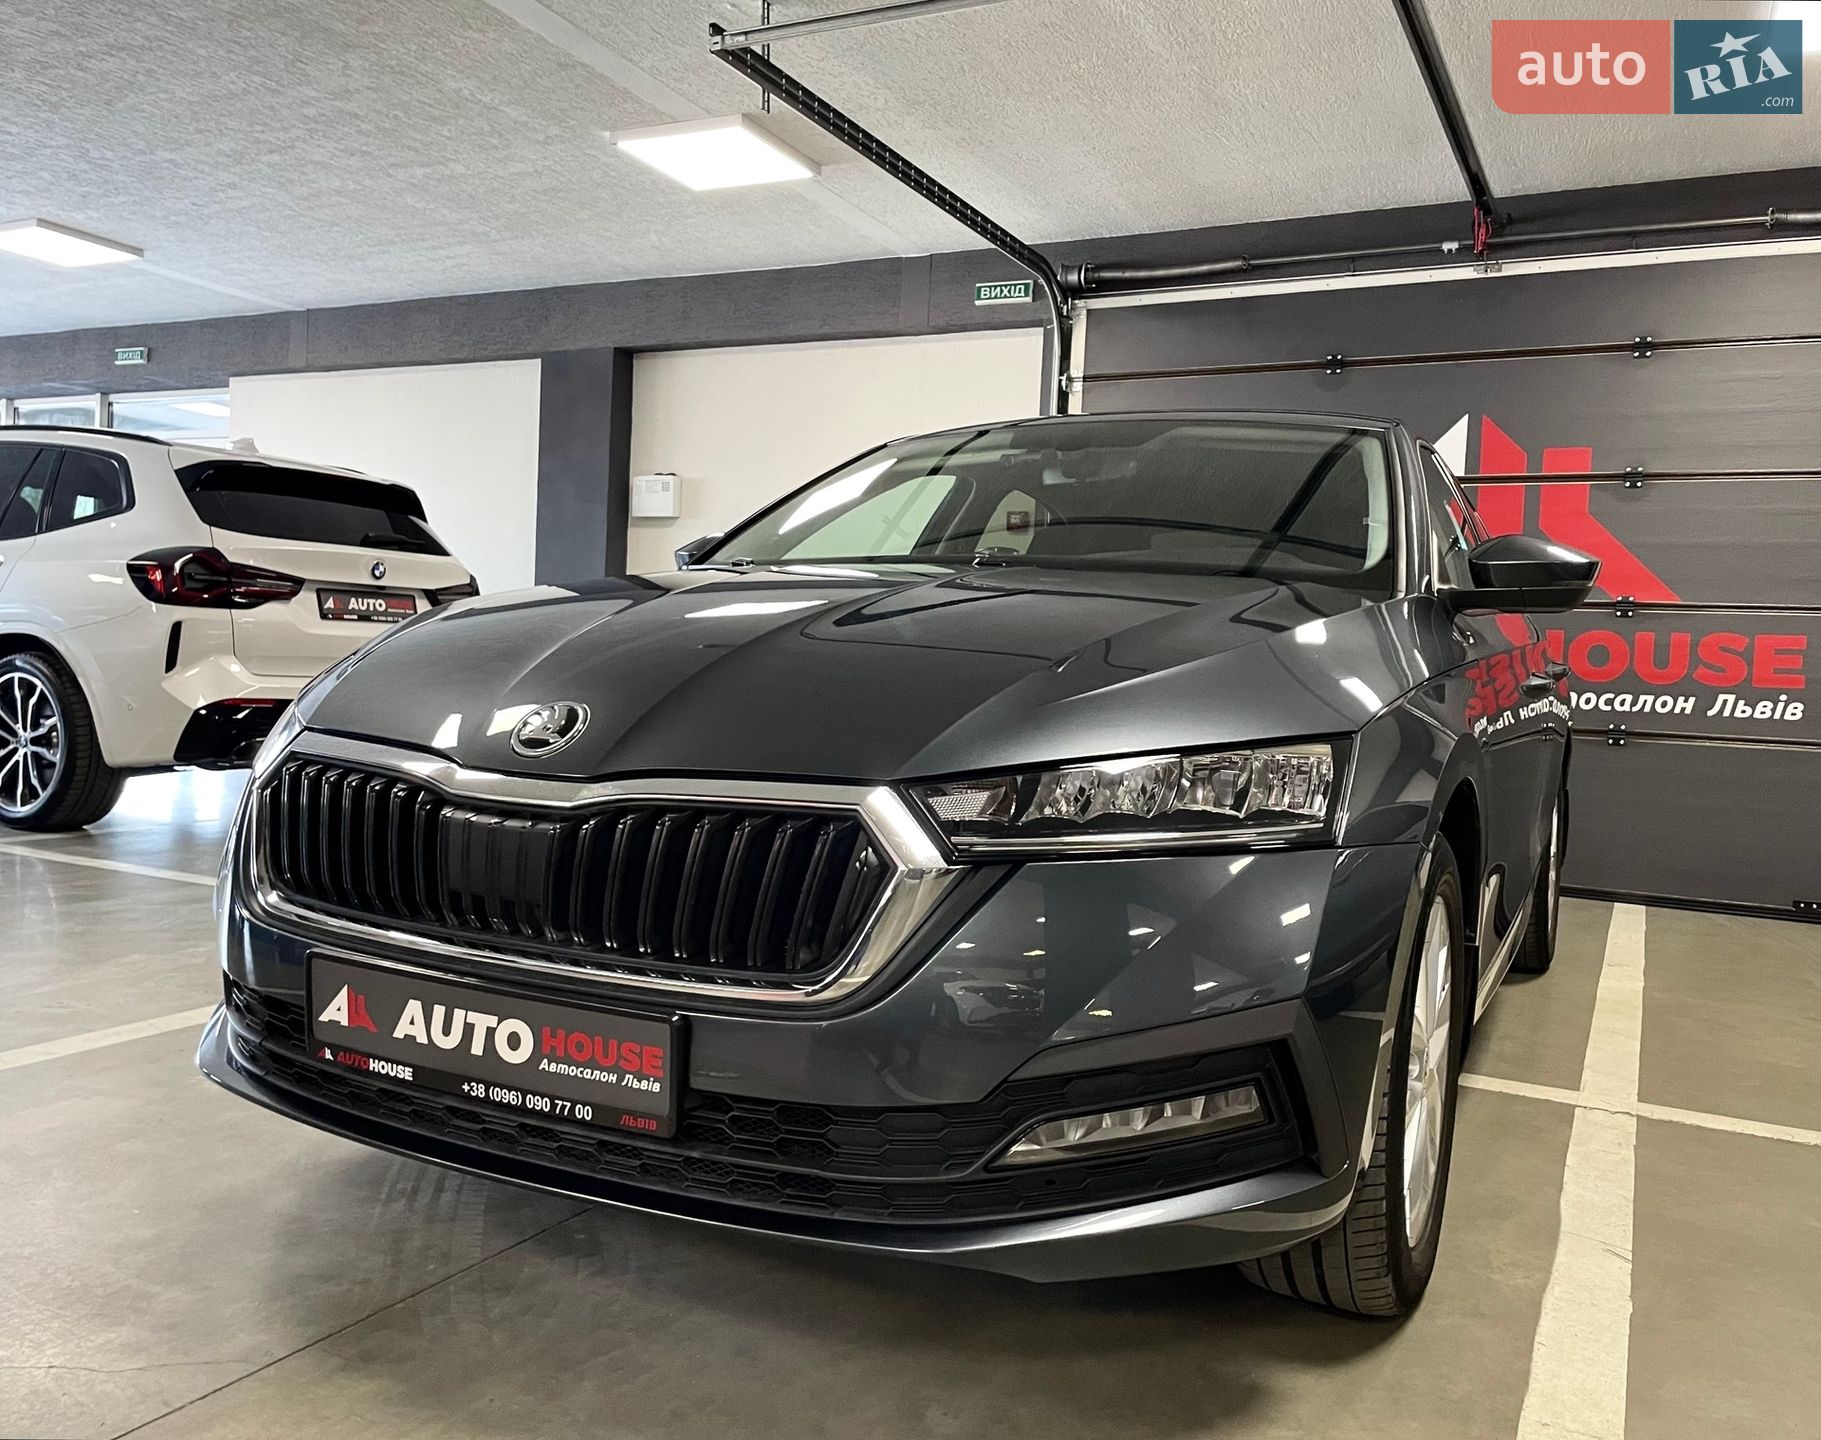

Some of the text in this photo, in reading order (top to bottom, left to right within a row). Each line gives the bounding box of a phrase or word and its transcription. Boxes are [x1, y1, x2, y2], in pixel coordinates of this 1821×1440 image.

[980, 284, 1025, 299] ВИХІД
[348, 597, 387, 612] AUTO
[1707, 694, 1805, 721] Львів
[392, 998, 665, 1078] AUTO HOUSE
[538, 1058, 661, 1093] Автосалон Львів
[462, 1082, 593, 1121] +38 (096) 090 77 00
